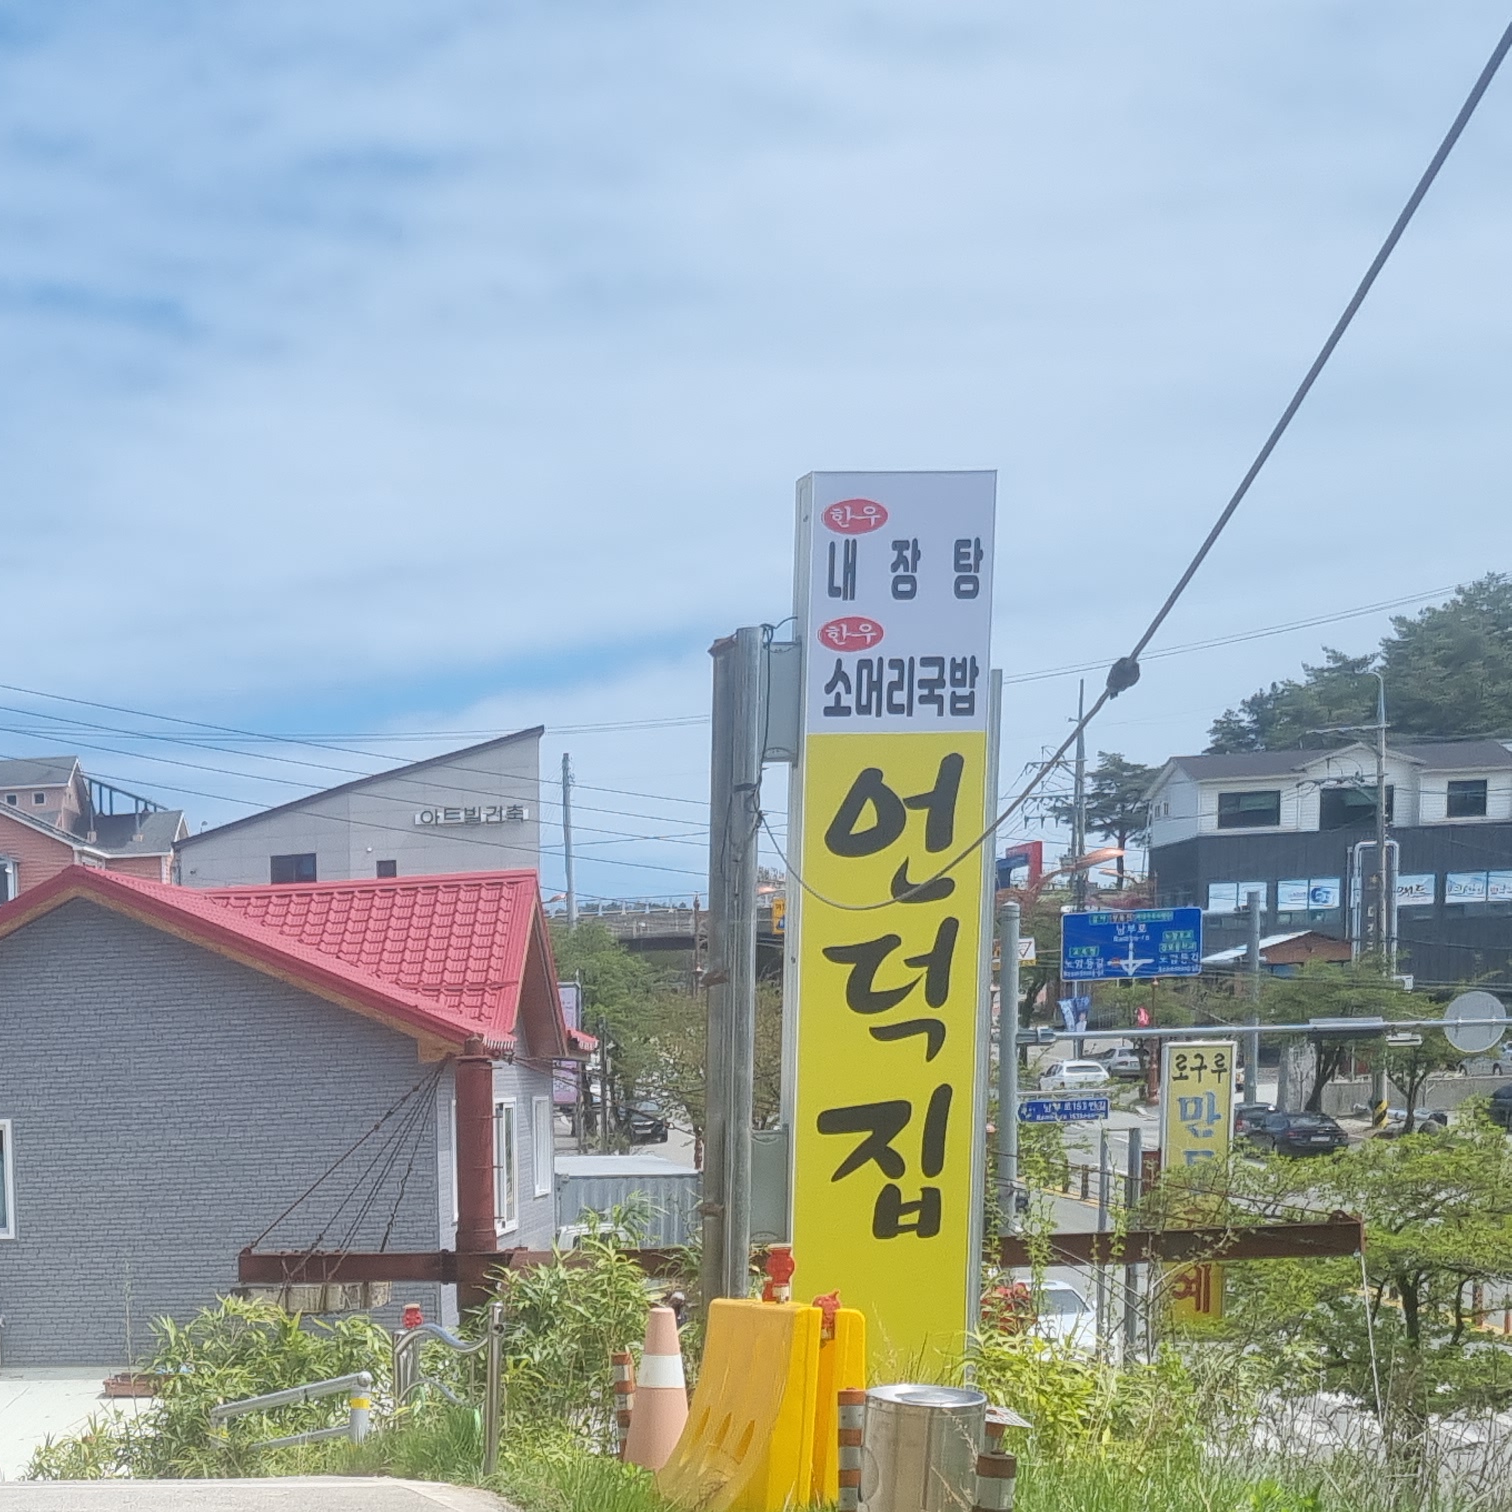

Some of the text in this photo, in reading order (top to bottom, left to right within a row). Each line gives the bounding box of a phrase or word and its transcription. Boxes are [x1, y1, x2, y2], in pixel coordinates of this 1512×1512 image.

[827, 503, 883, 530] 한우
[827, 537, 983, 601] 내장탕
[823, 621, 879, 647] 한우
[823, 655, 979, 718] 소머리국밥
[419, 803, 524, 825] 아트빌건축
[817, 752, 965, 1239] 언덕집
[1172, 1053, 1227, 1083] 로구루
